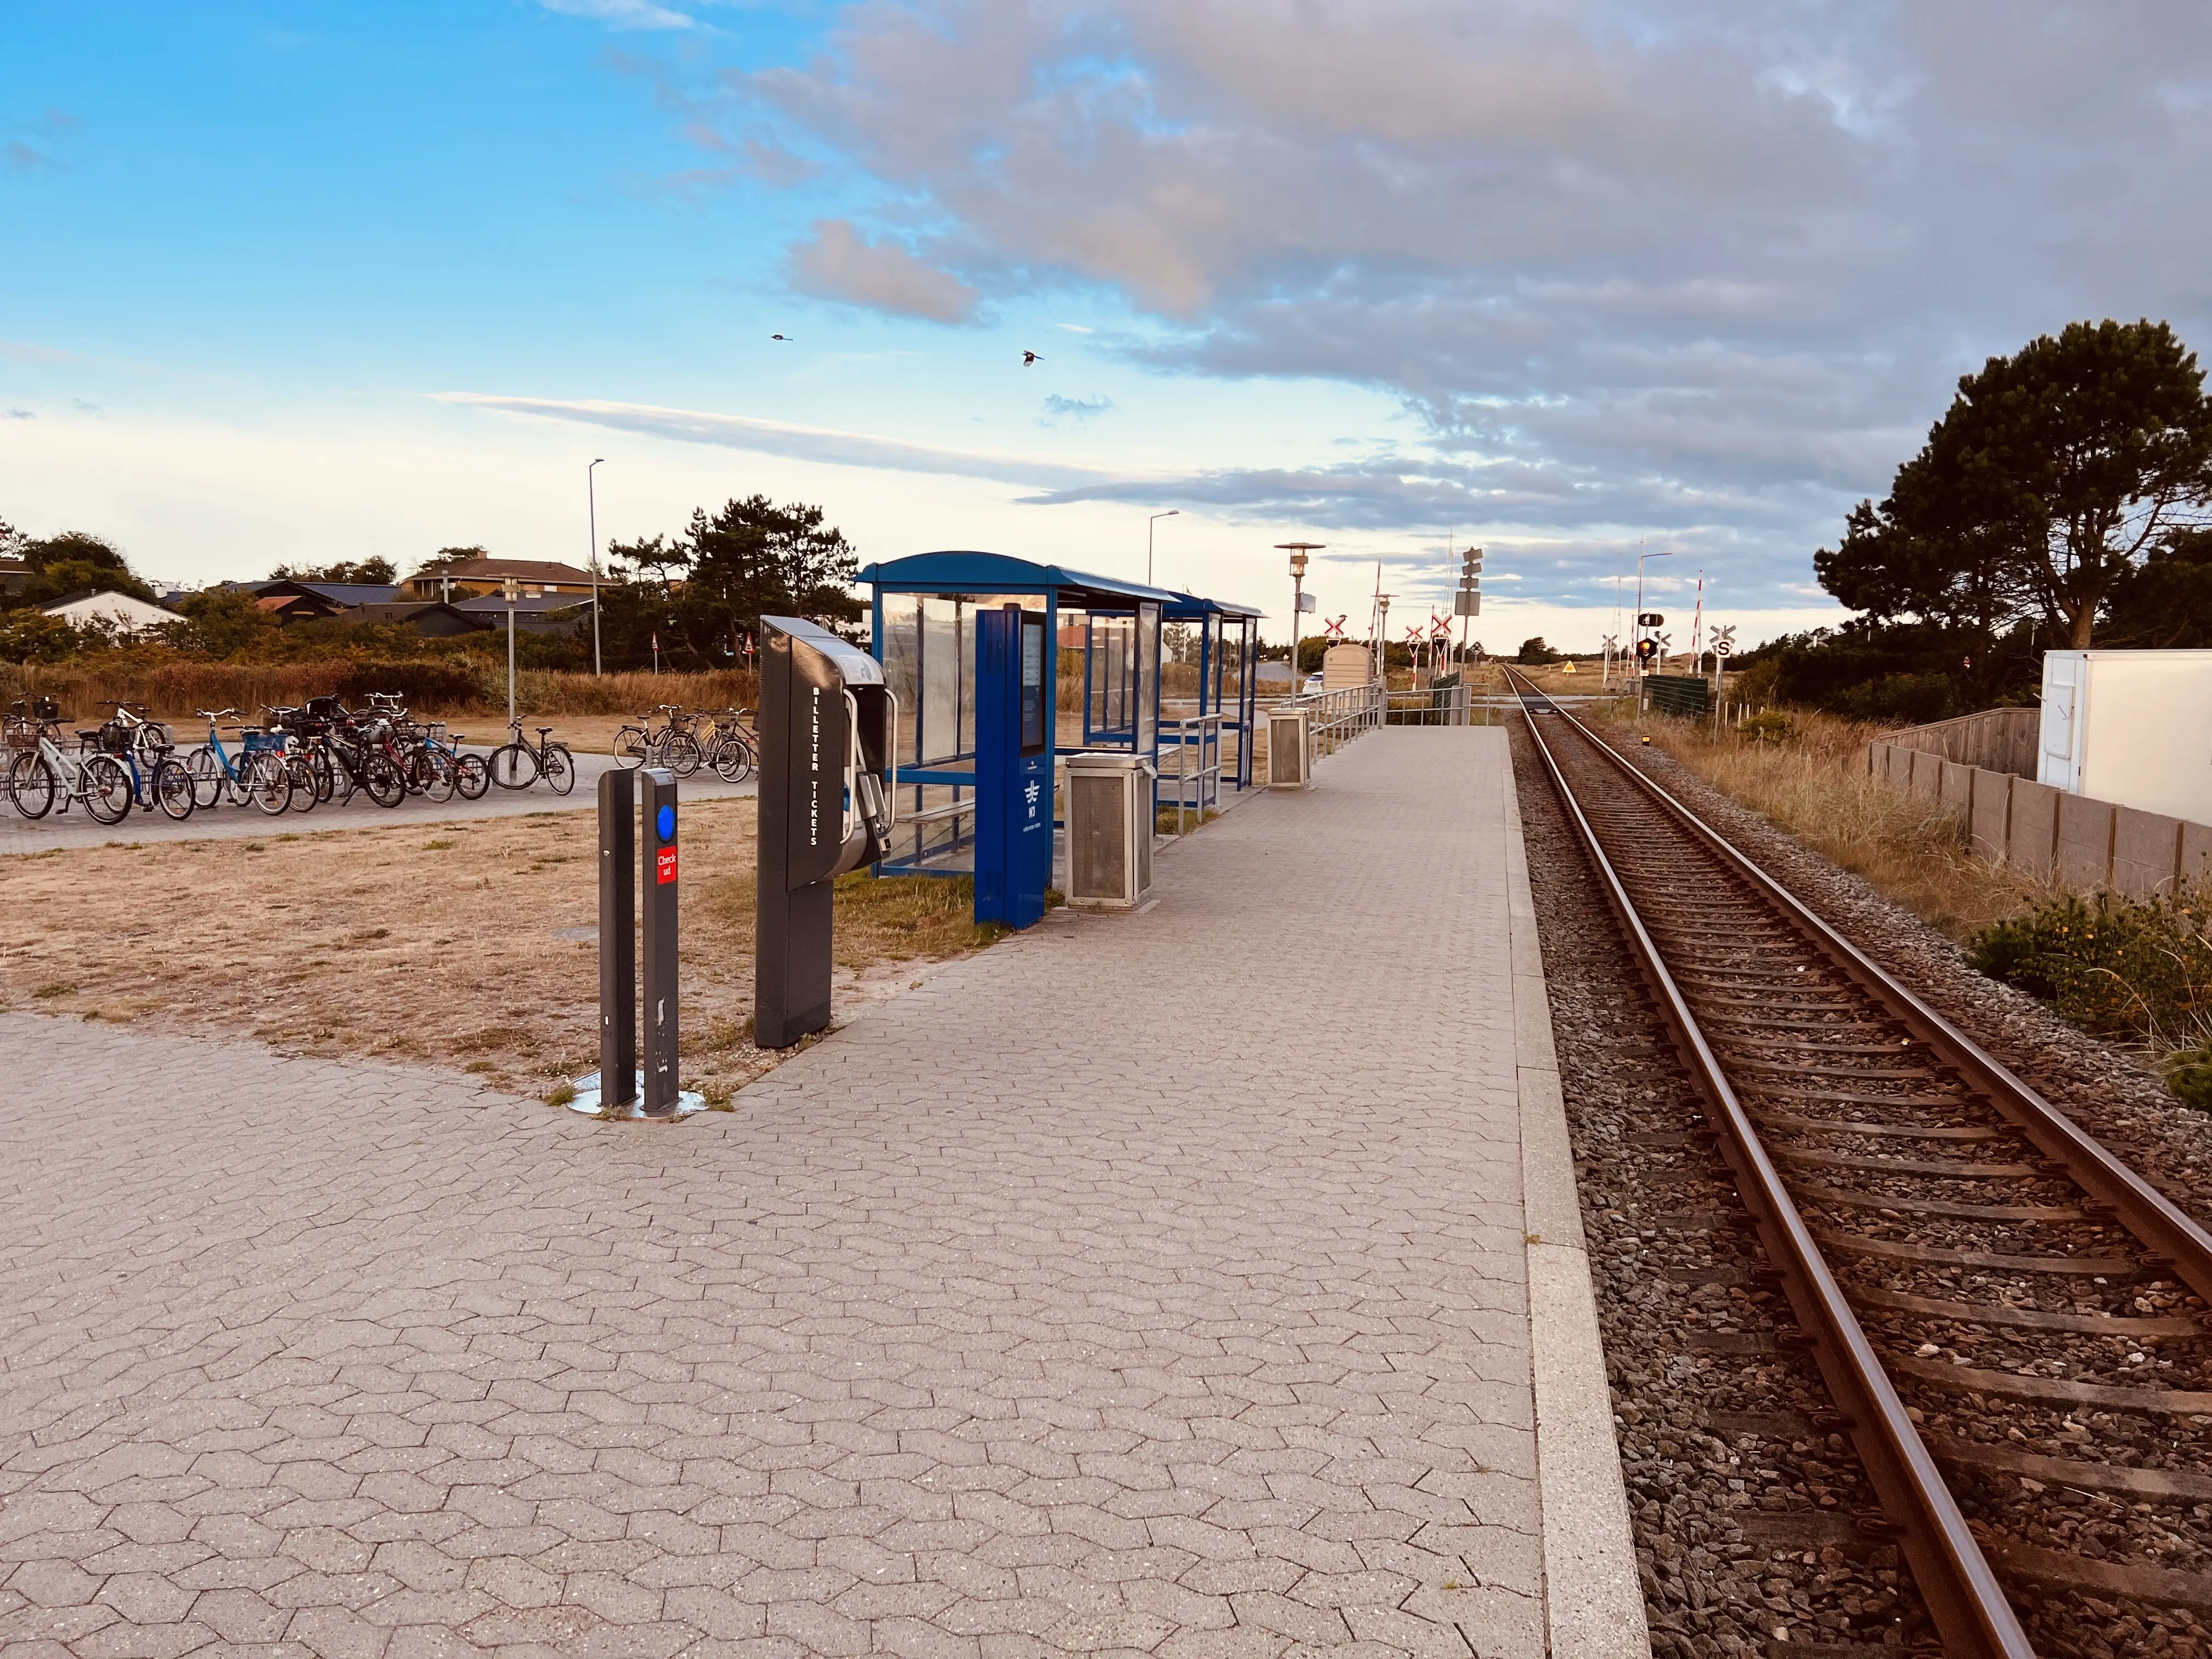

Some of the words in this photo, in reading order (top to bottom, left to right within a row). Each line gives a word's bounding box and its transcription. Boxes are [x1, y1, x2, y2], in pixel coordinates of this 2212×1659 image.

[1717, 641, 1730, 656] S
[811, 687, 820, 771] BILLETTER
[658, 854, 676, 866] Check
[663, 865, 672, 876] ud
